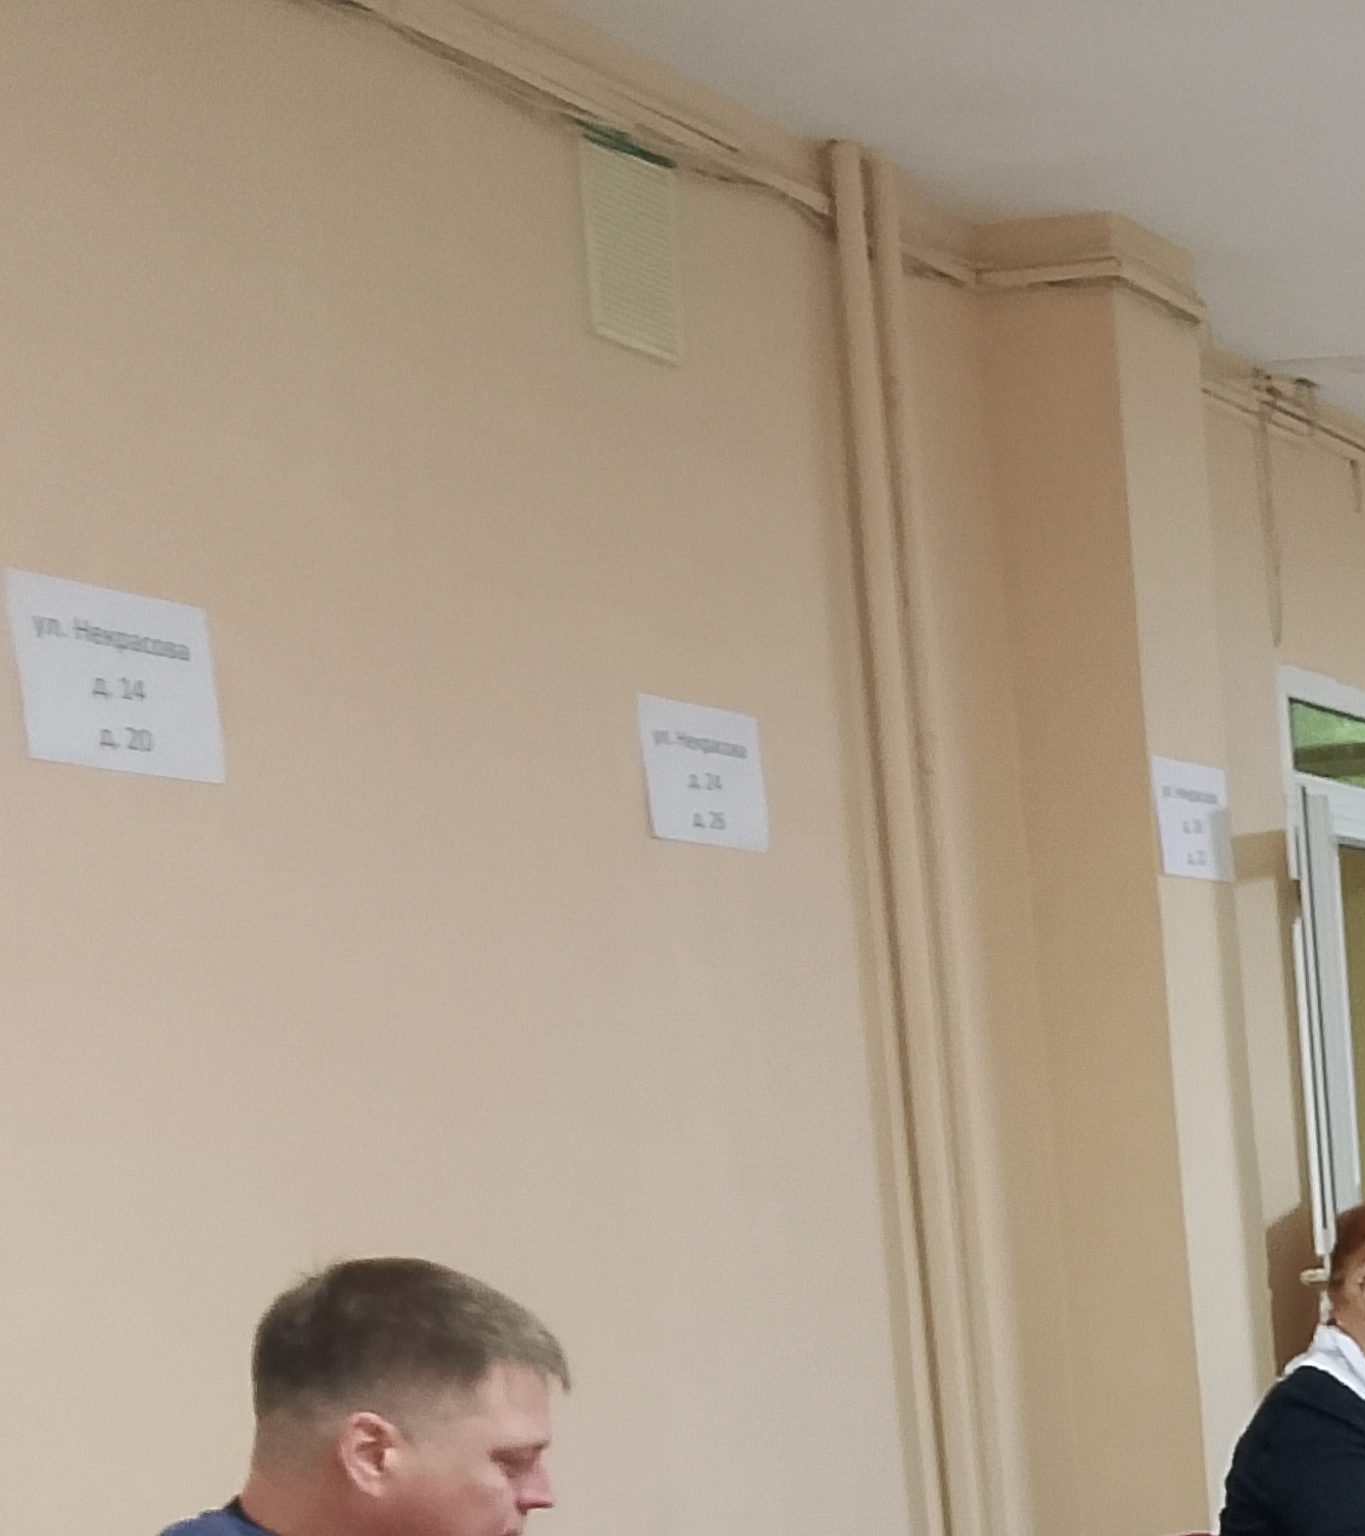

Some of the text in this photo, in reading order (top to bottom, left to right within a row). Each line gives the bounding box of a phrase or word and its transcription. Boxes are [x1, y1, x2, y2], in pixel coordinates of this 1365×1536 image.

[31, 616, 191, 662] ул. Некрасова
[119, 676, 147, 701] 14
[125, 727, 154, 752] 20
